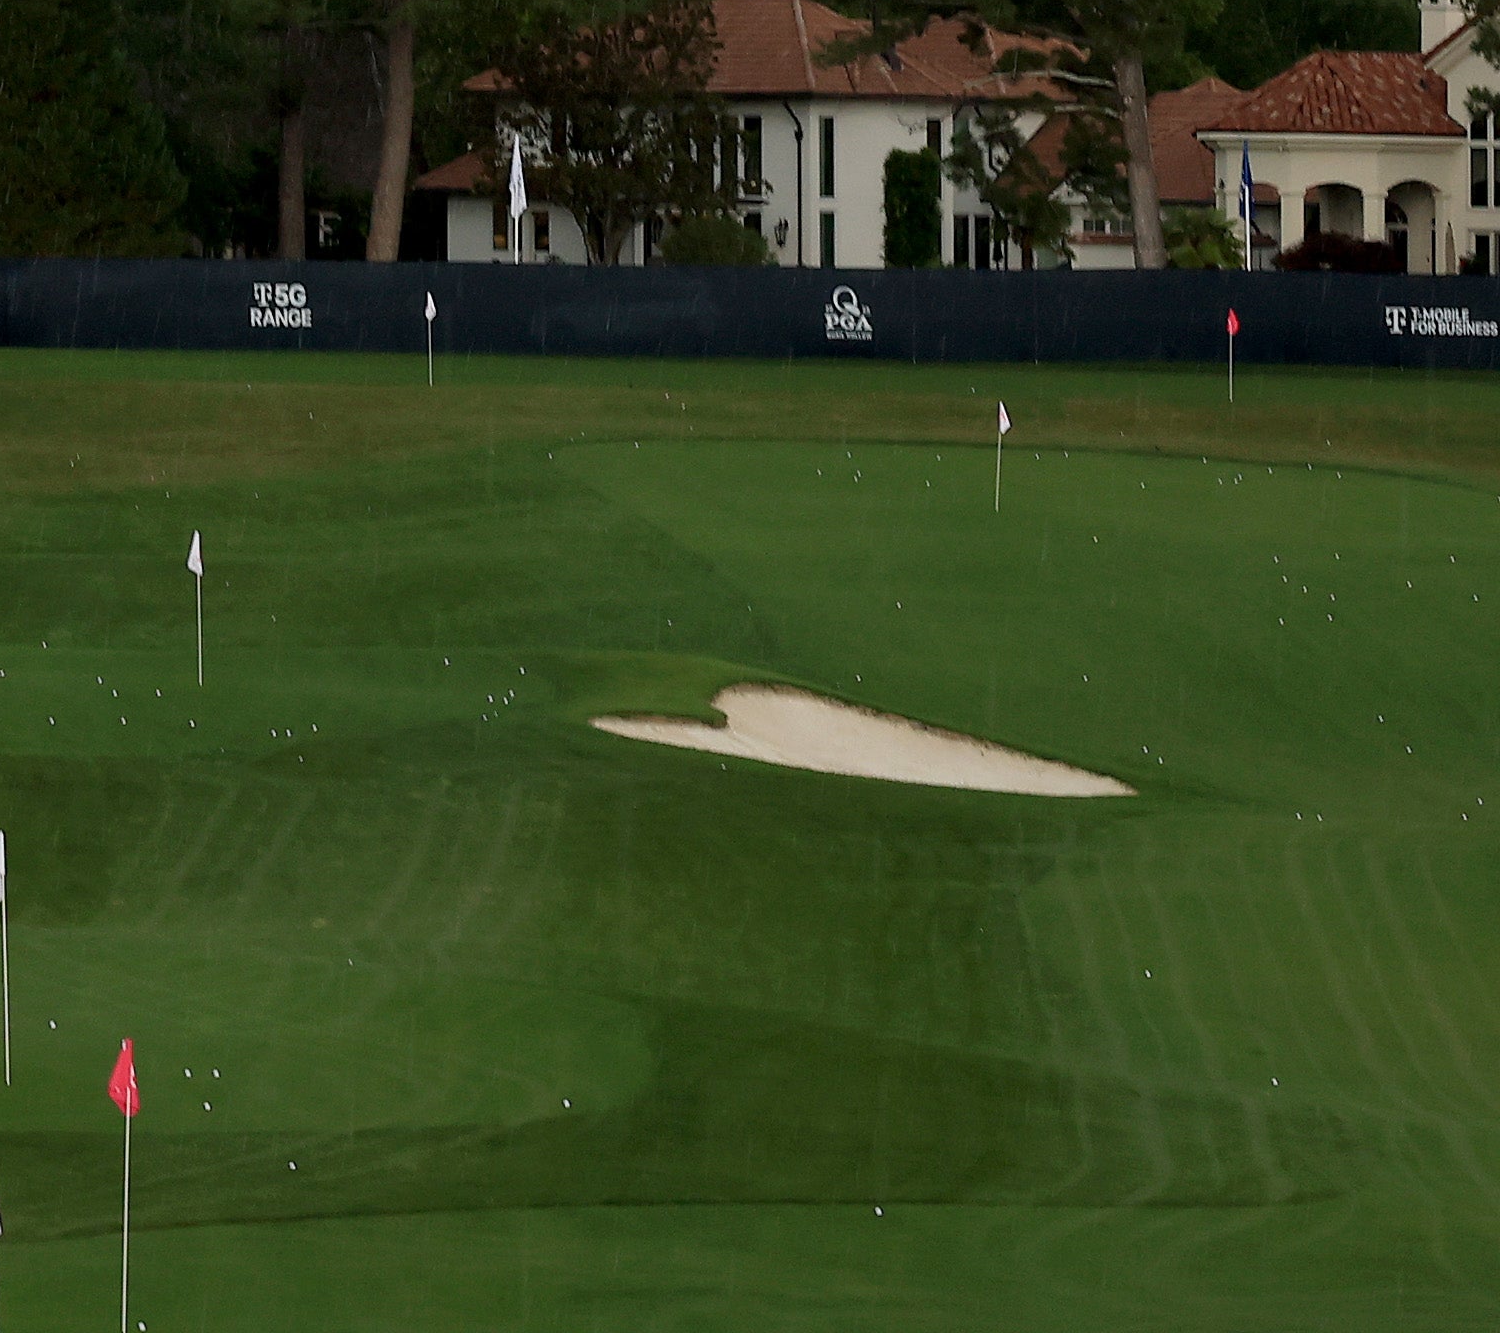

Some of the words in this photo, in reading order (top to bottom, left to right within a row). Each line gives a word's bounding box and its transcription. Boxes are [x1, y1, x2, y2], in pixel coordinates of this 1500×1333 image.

[250, 307, 312, 328] RANGE
[824, 313, 873, 331] PGA
[1411, 319, 1436, 335] FOR
[1438, 319, 1498, 337] BUSINESS
